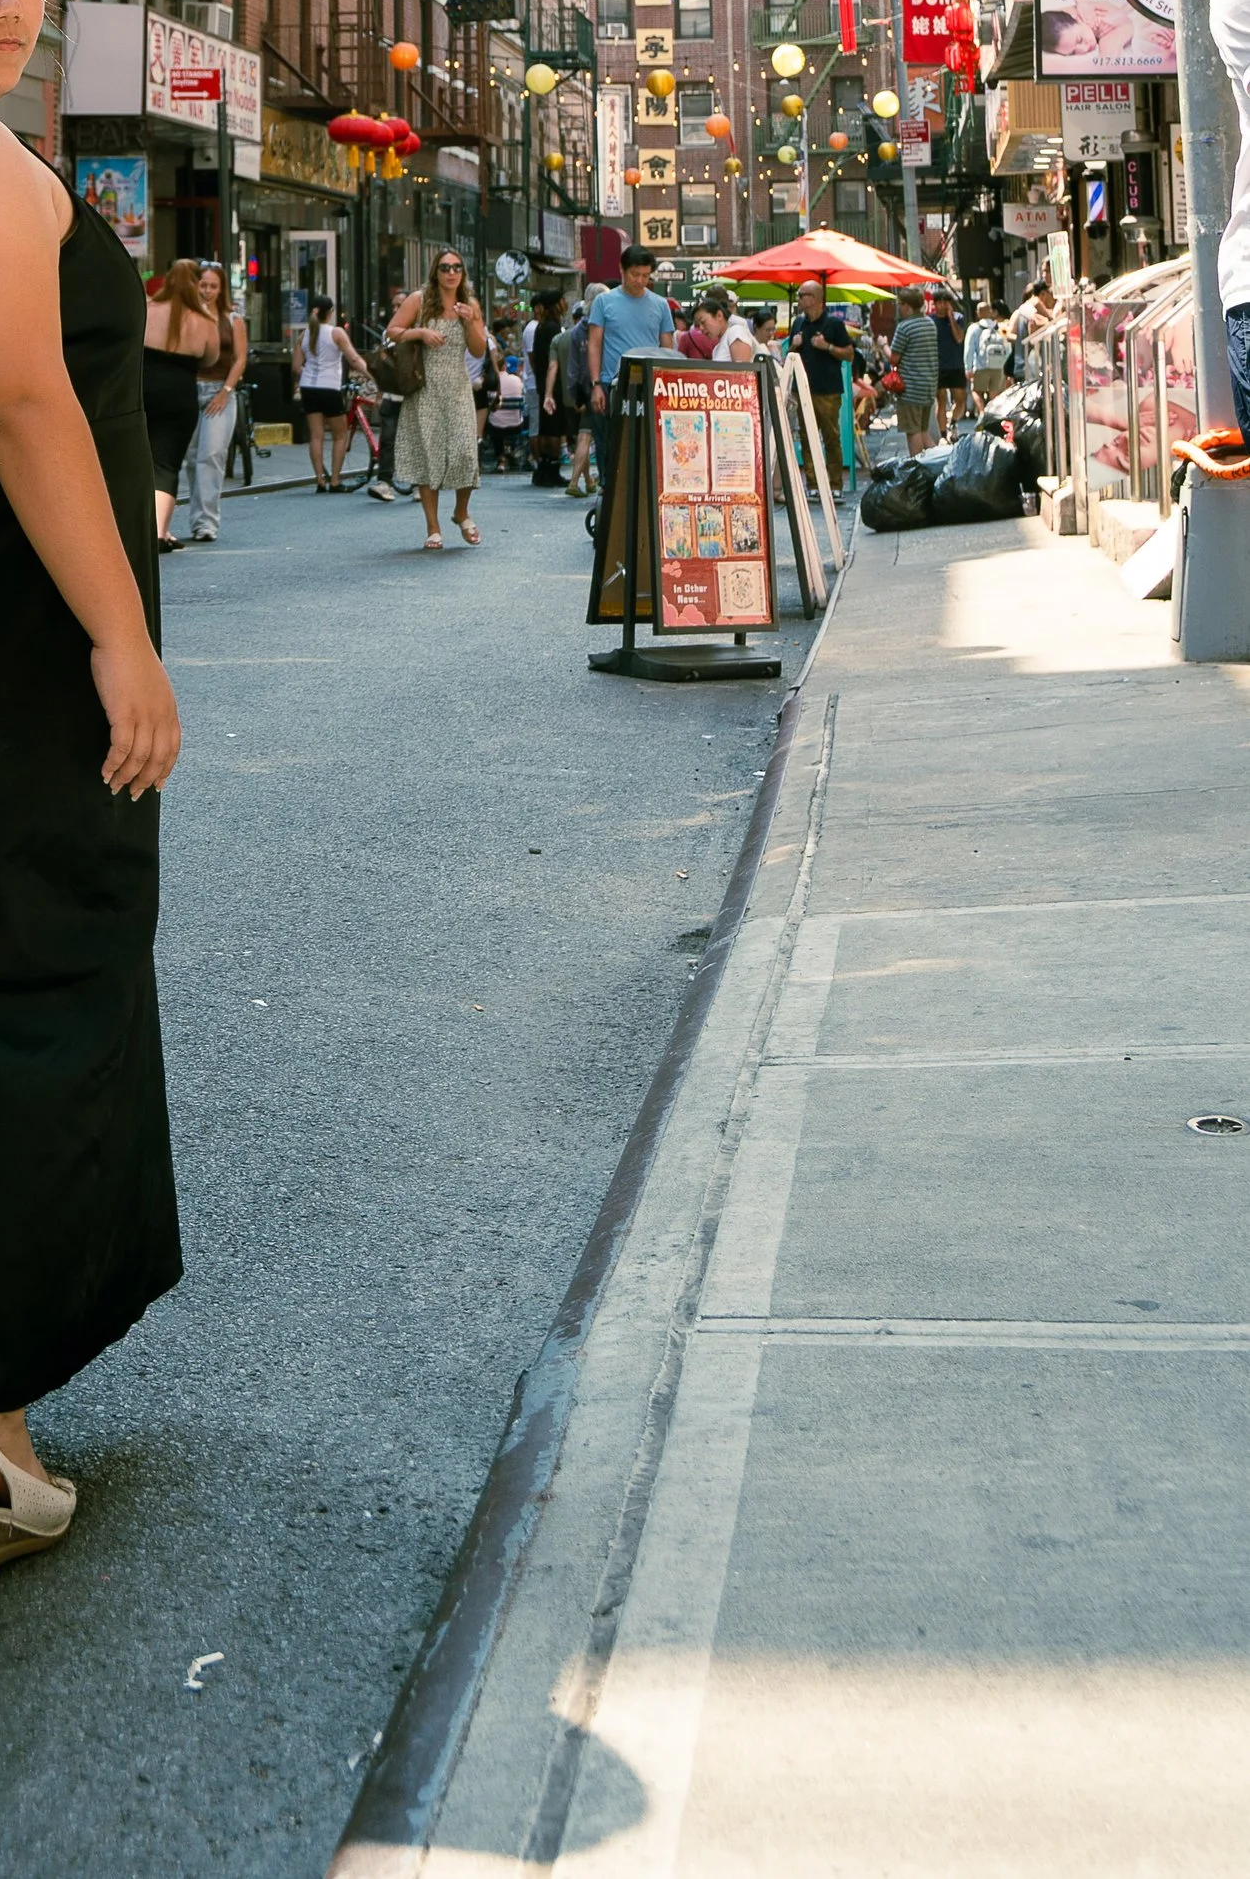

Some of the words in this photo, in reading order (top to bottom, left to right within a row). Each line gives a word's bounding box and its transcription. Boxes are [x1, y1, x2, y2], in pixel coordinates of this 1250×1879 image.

[1092, 57, 1163, 67] 917.813.6669
[1067, 84, 1129, 101] PELL
[1066, 104, 1091, 112] HAIR
[1095, 103, 1131, 111] SALON
[1127, 161, 1139, 209] CLUB
[1015, 211, 1047, 222] ATM
[654, 377, 707, 397] Anime
[713, 379, 752, 399] Claw
[669, 395, 741, 410] Newsboard
[688, 494, 702, 502] New
[704, 494, 731, 502] Arrivals
[673, 584, 682, 593] In
[684, 584, 708, 593] Other
